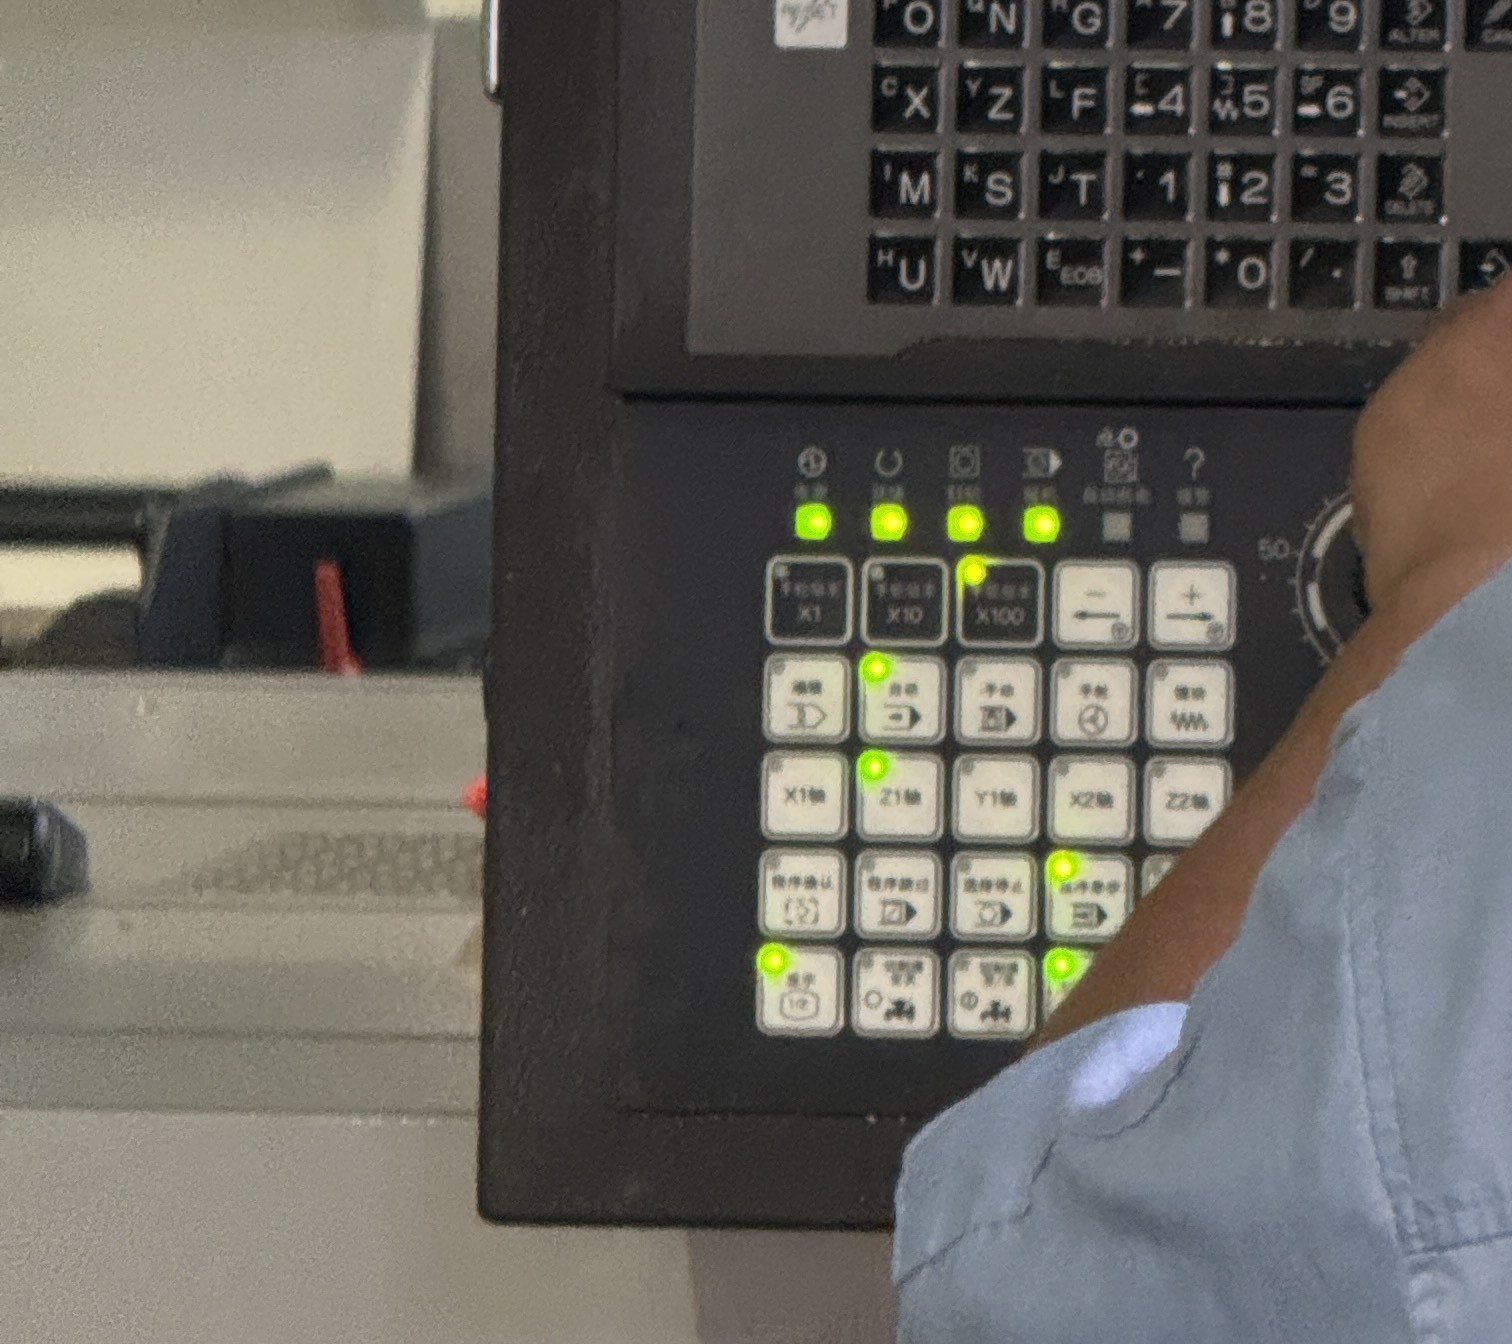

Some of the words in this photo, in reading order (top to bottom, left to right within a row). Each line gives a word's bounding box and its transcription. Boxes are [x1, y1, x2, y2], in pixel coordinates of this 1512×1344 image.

[988, 1, 1017, 35] N
[1071, 1, 1102, 36] G
[903, 86, 932, 120] X
[987, 85, 1015, 121] Z
[1070, 86, 1098, 121] F
[1157, 83, 1185, 118] 4
[1242, 83, 1270, 119] 5
[1325, 84, 1354, 120] 6
[900, 170, 931, 205] M
[985, 171, 1014, 206] S
[1068, 171, 1097, 206] T
[1159, 169, 1177, 203] 1
[1239, 170, 1269, 205] 2
[1323, 170, 1352, 205] 3
[899, 257, 927, 291] U
[981, 258, 1014, 292] W
[1257, 536, 1290, 560] 50
[886, 606, 924, 625] X10
[975, 606, 1026, 626] X100
